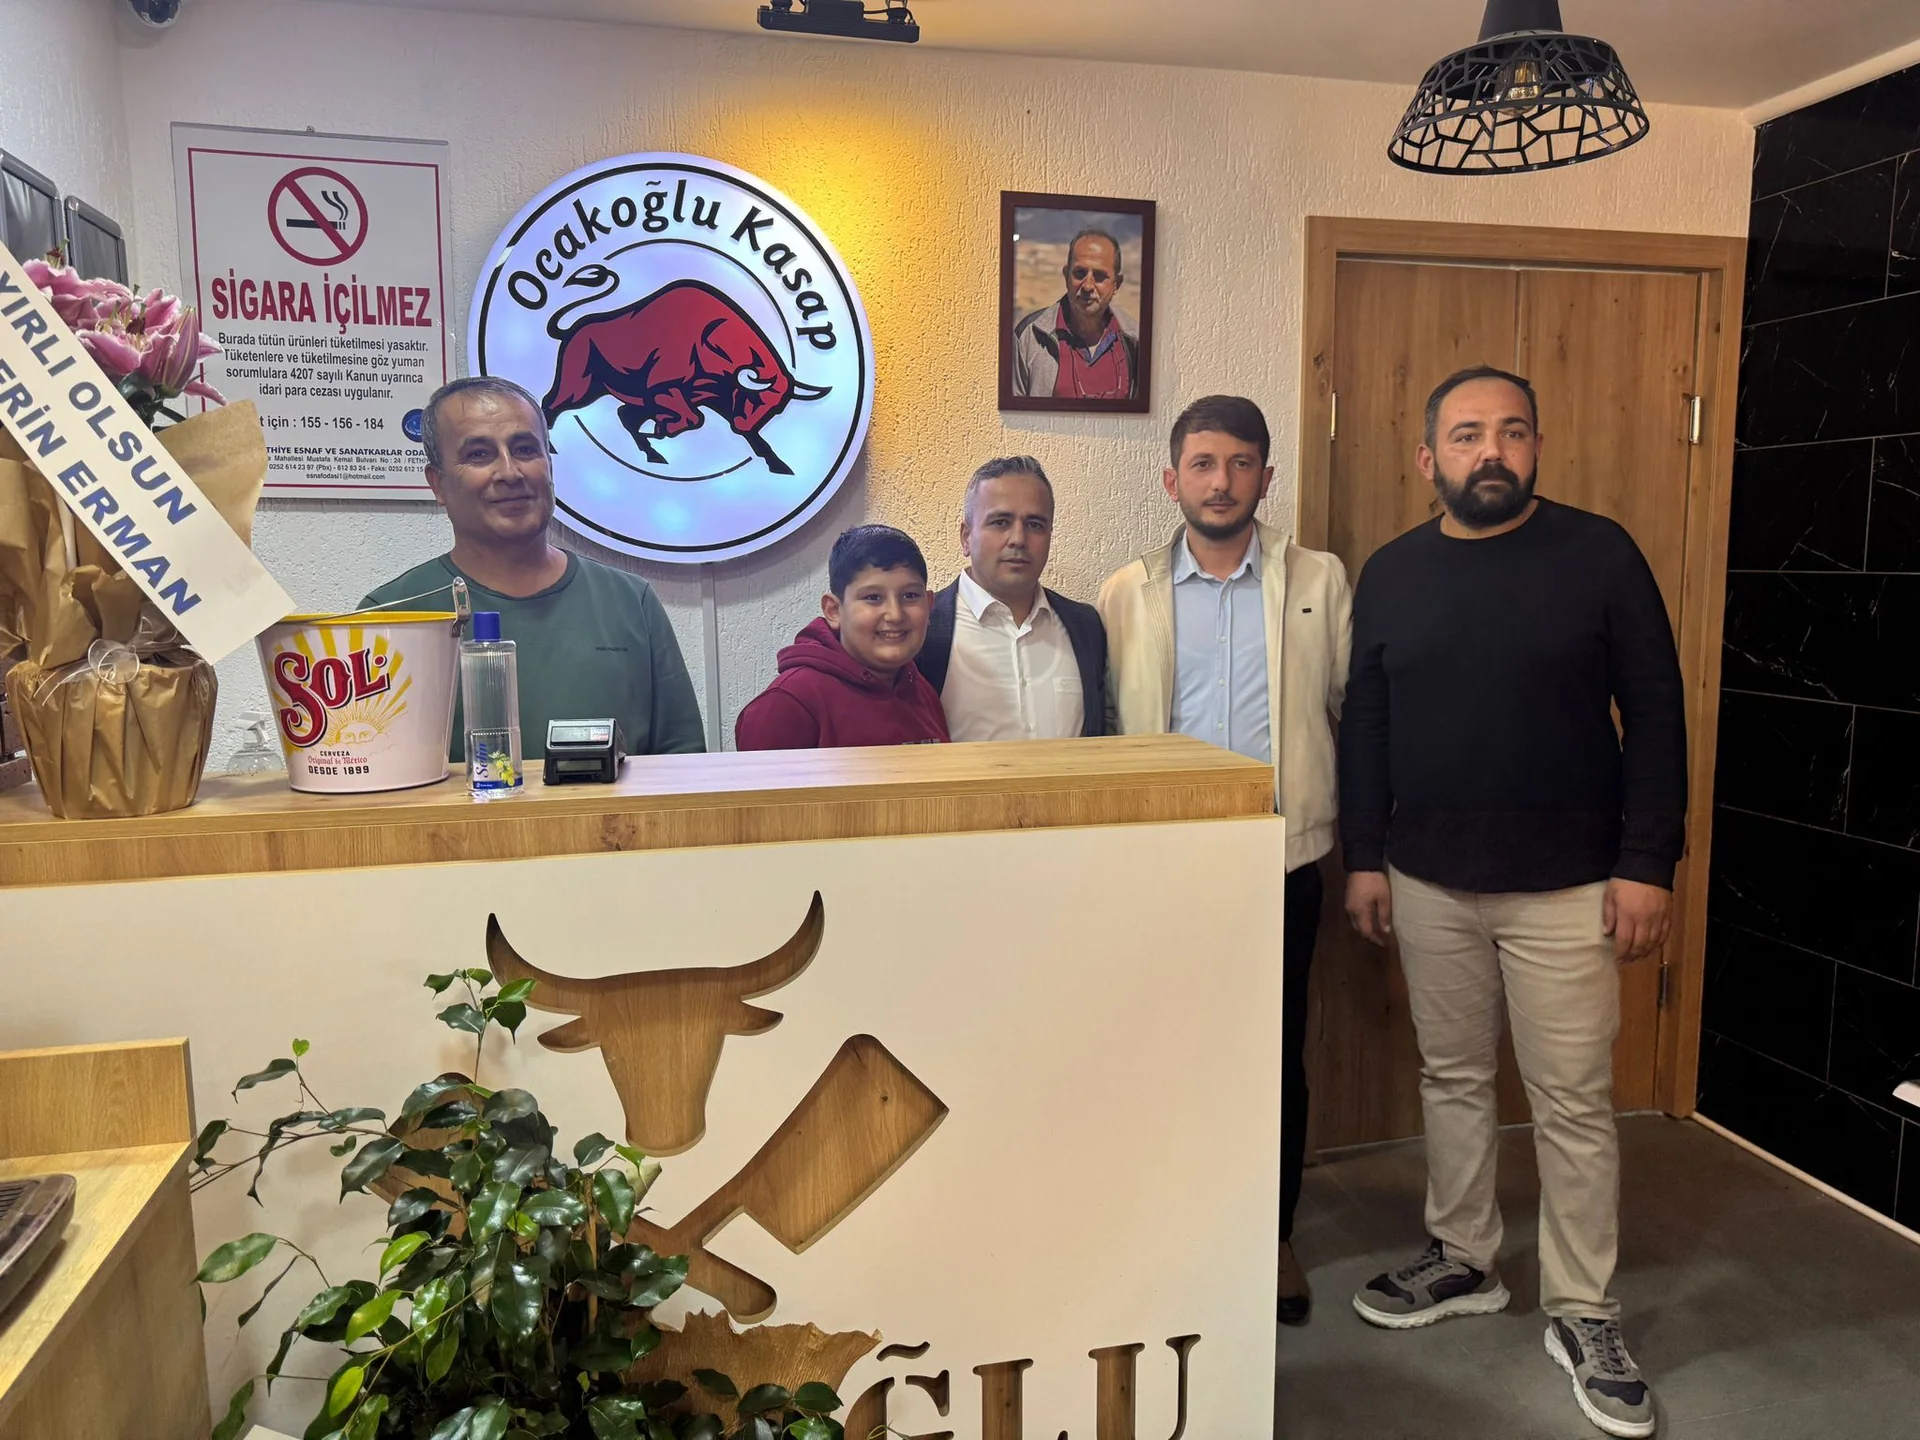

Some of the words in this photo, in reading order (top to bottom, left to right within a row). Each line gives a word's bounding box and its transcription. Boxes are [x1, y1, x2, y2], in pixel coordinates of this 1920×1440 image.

[507, 179, 721, 311] Ocakoğlu
[730, 206, 836, 350] Kasap
[212, 268, 316, 322] SİGARA
[324, 273, 432, 334] İÇİLMEZ
[219, 332, 255, 345] Burada
[258, 334, 285, 346] tütün
[288, 335, 327, 348] ürünleri
[330, 337, 384, 350] tüketilmesi
[387, 340, 428, 353] yasaktır.
[224, 349, 284, 362] Tüketenlere
[287, 354, 298, 363] ve
[301, 351, 368, 365] tüketilmesine
[371, 354, 389, 368] göz
[392, 358, 424, 369] yuman
[226, 367, 288, 379] sorumlulara
[290, 368, 314, 380] 4207
[317, 369, 343, 383] sayılı
[346, 370, 378, 382] Kanun
[381, 374, 423, 385] uyarınca
[0, 270, 76, 377] YIRLI
[68, 381, 197, 526] OLSUN
[259, 383, 282, 395] idari
[285, 387, 307, 398] para
[310, 387, 341, 397] cezası
[344, 386, 393, 400] uygulanır.
[267, 415, 289, 430] için
[301, 416, 321, 428] 155
[332, 417, 352, 429] 156
[364, 418, 384, 429] 184
[266, 445, 291, 454] THİYE
[339, 448, 402, 456] SANATKARLAR
[57, 459, 202, 617] ERMAN
[308, 755, 333, 765] Original
[308, 765, 338, 775] DESDE
[344, 765, 369, 775] 1899
[843, 1333, 1202, 1440] ĞLU
